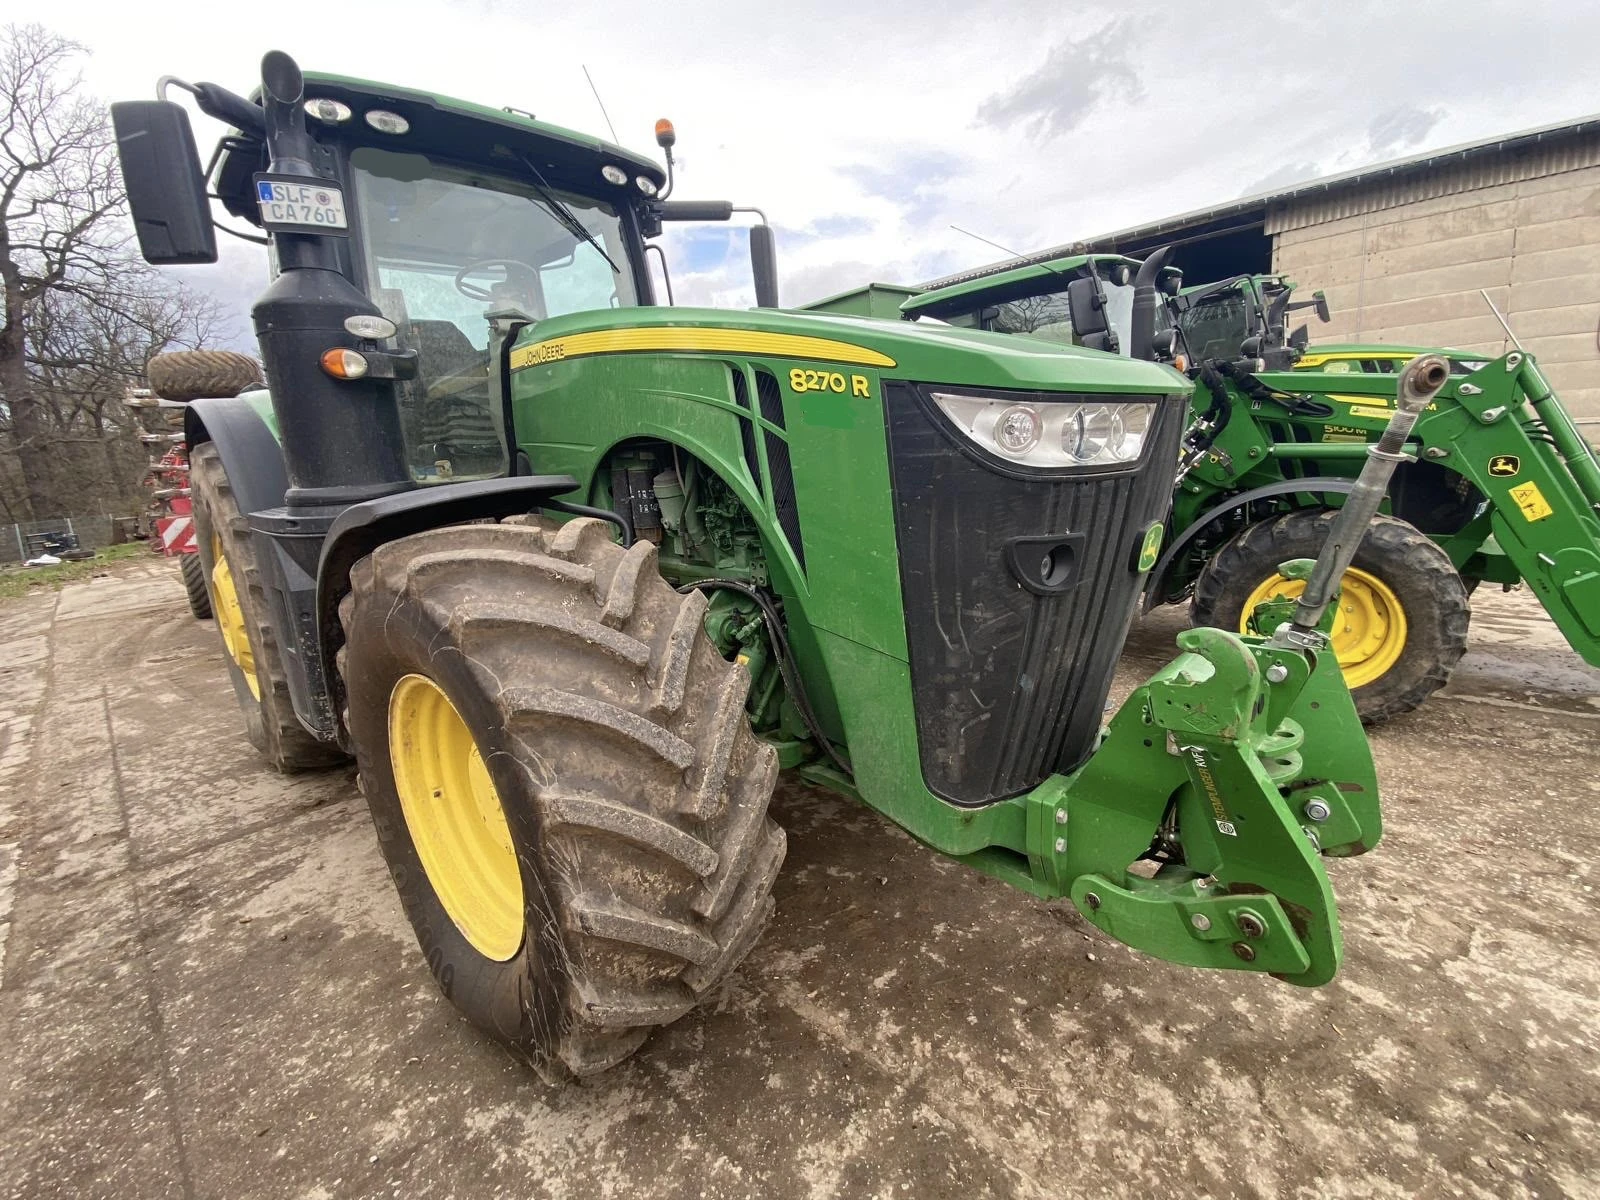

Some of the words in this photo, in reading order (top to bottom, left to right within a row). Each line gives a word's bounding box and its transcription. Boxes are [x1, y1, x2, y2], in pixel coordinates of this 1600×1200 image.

[273, 186, 311, 203] SLF
[271, 204, 297, 220] CA
[300, 206, 337, 225] 760
[525, 350, 541, 365] JOHN
[541, 344, 565, 360] DEERE
[789, 368, 846, 393] 8270
[851, 375, 871, 397] R
[1324, 424, 1354, 433] 5100
